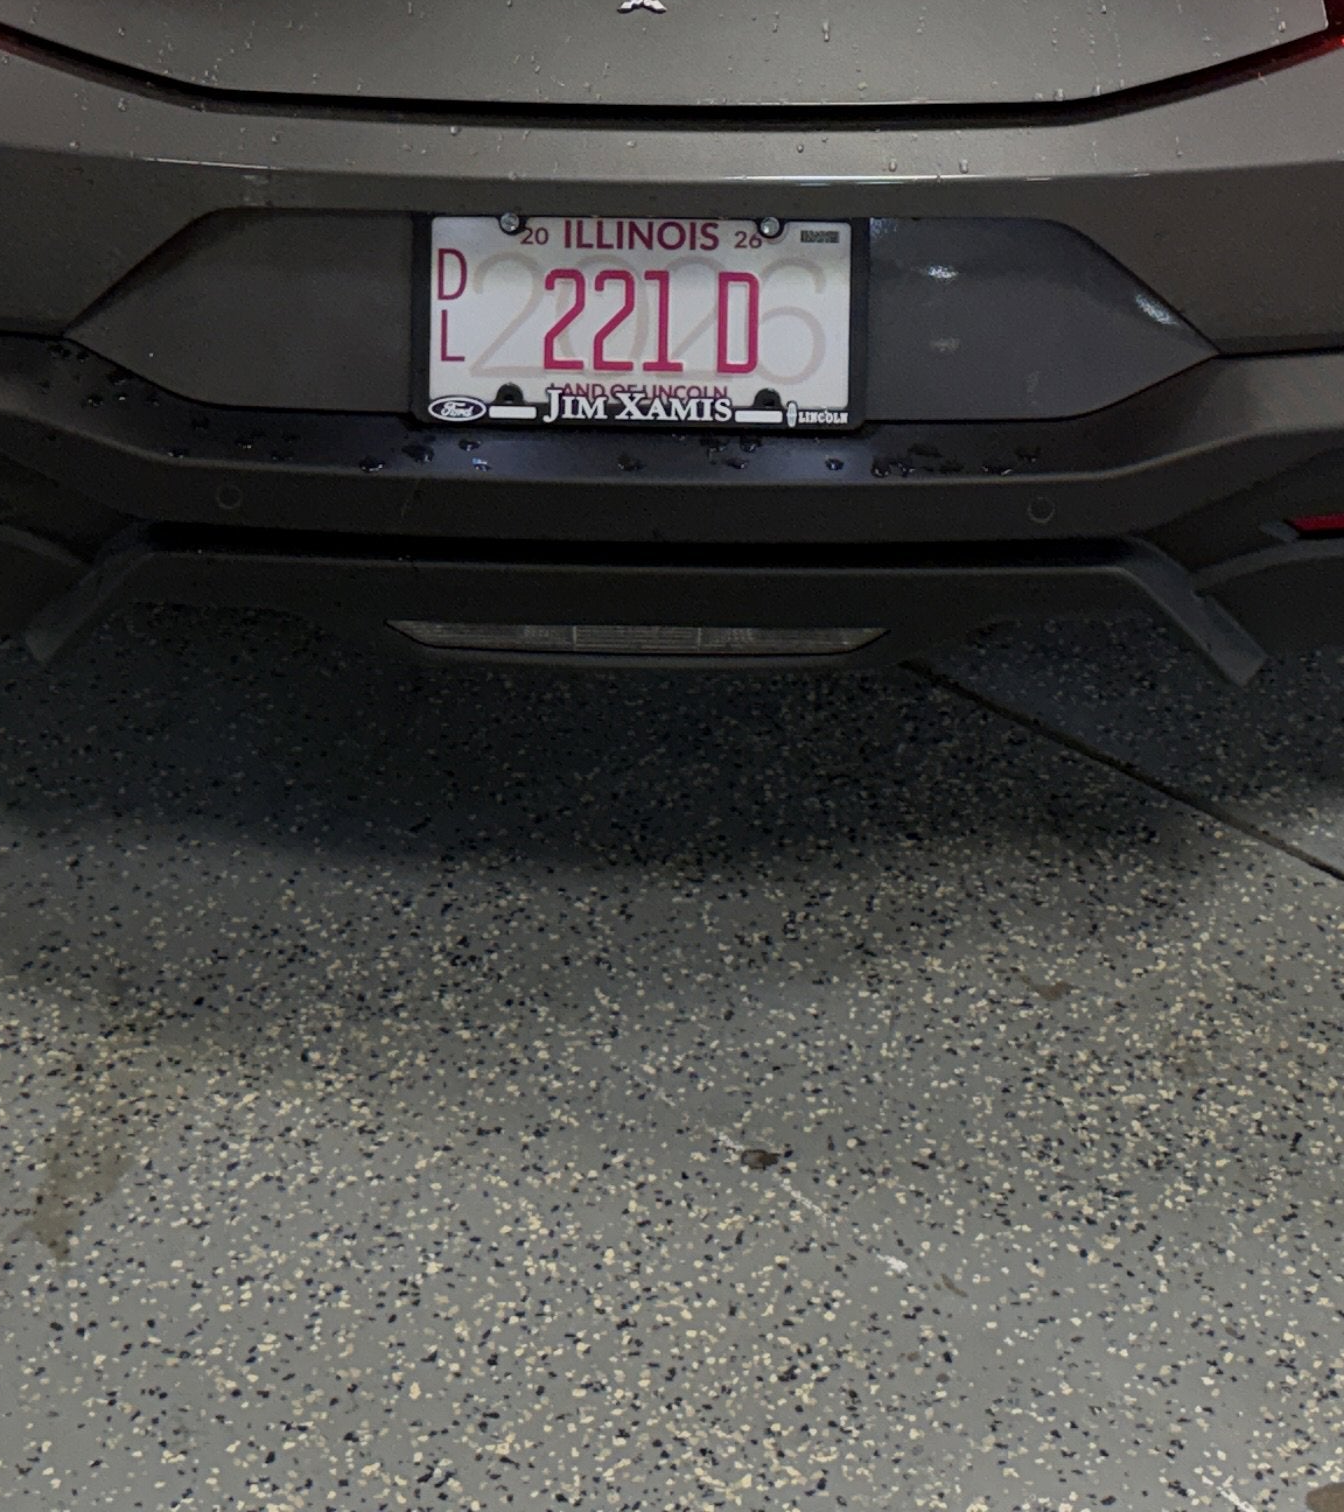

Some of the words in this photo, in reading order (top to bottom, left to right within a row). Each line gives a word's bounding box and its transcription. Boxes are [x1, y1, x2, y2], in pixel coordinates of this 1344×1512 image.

[520, 227, 549, 245] 20
[563, 220, 720, 251] ILLINOIS
[734, 230, 762, 249] 26
[544, 268, 684, 372] 221
[717, 272, 760, 374] D
[543, 389, 608, 423] JIM
[614, 392, 733, 422] XAMIS
[798, 410, 849, 424] LINCOLN
